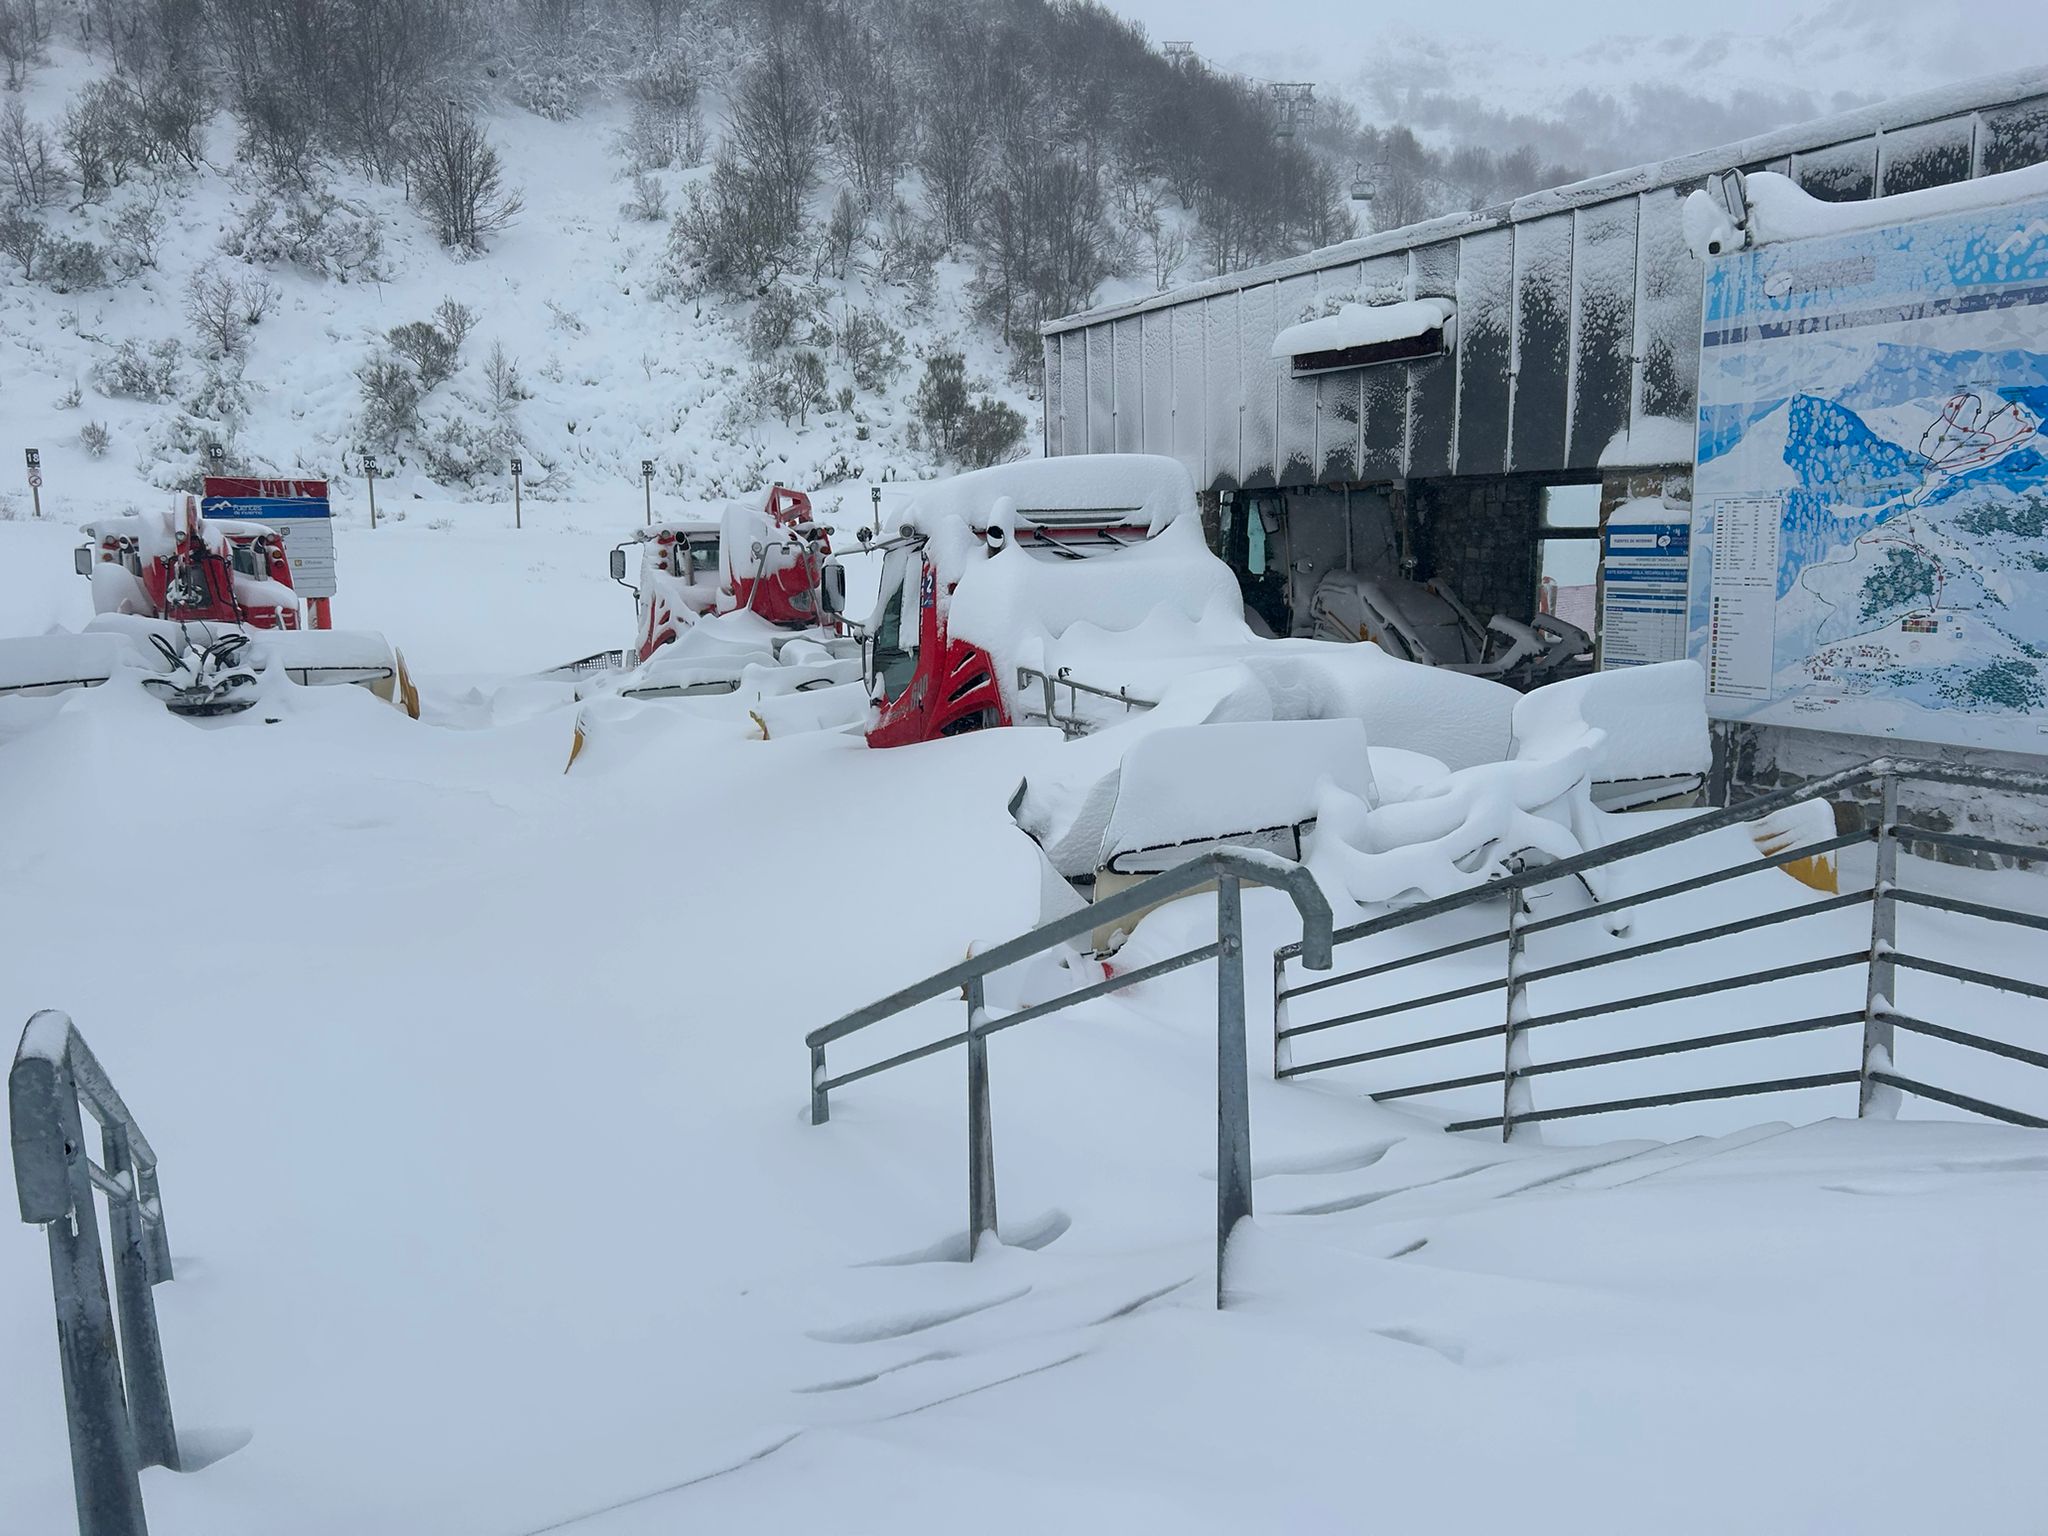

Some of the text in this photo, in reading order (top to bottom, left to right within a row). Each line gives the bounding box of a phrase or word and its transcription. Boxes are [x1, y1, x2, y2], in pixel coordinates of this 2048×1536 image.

[210, 448, 222, 457] 19
[27, 453, 39, 463] 18
[364, 460, 376, 469] 20
[511, 462, 521, 471] 21
[642, 463, 653, 472] 22
[872, 491, 881, 499] 24
[926, 575, 933, 594] 2
